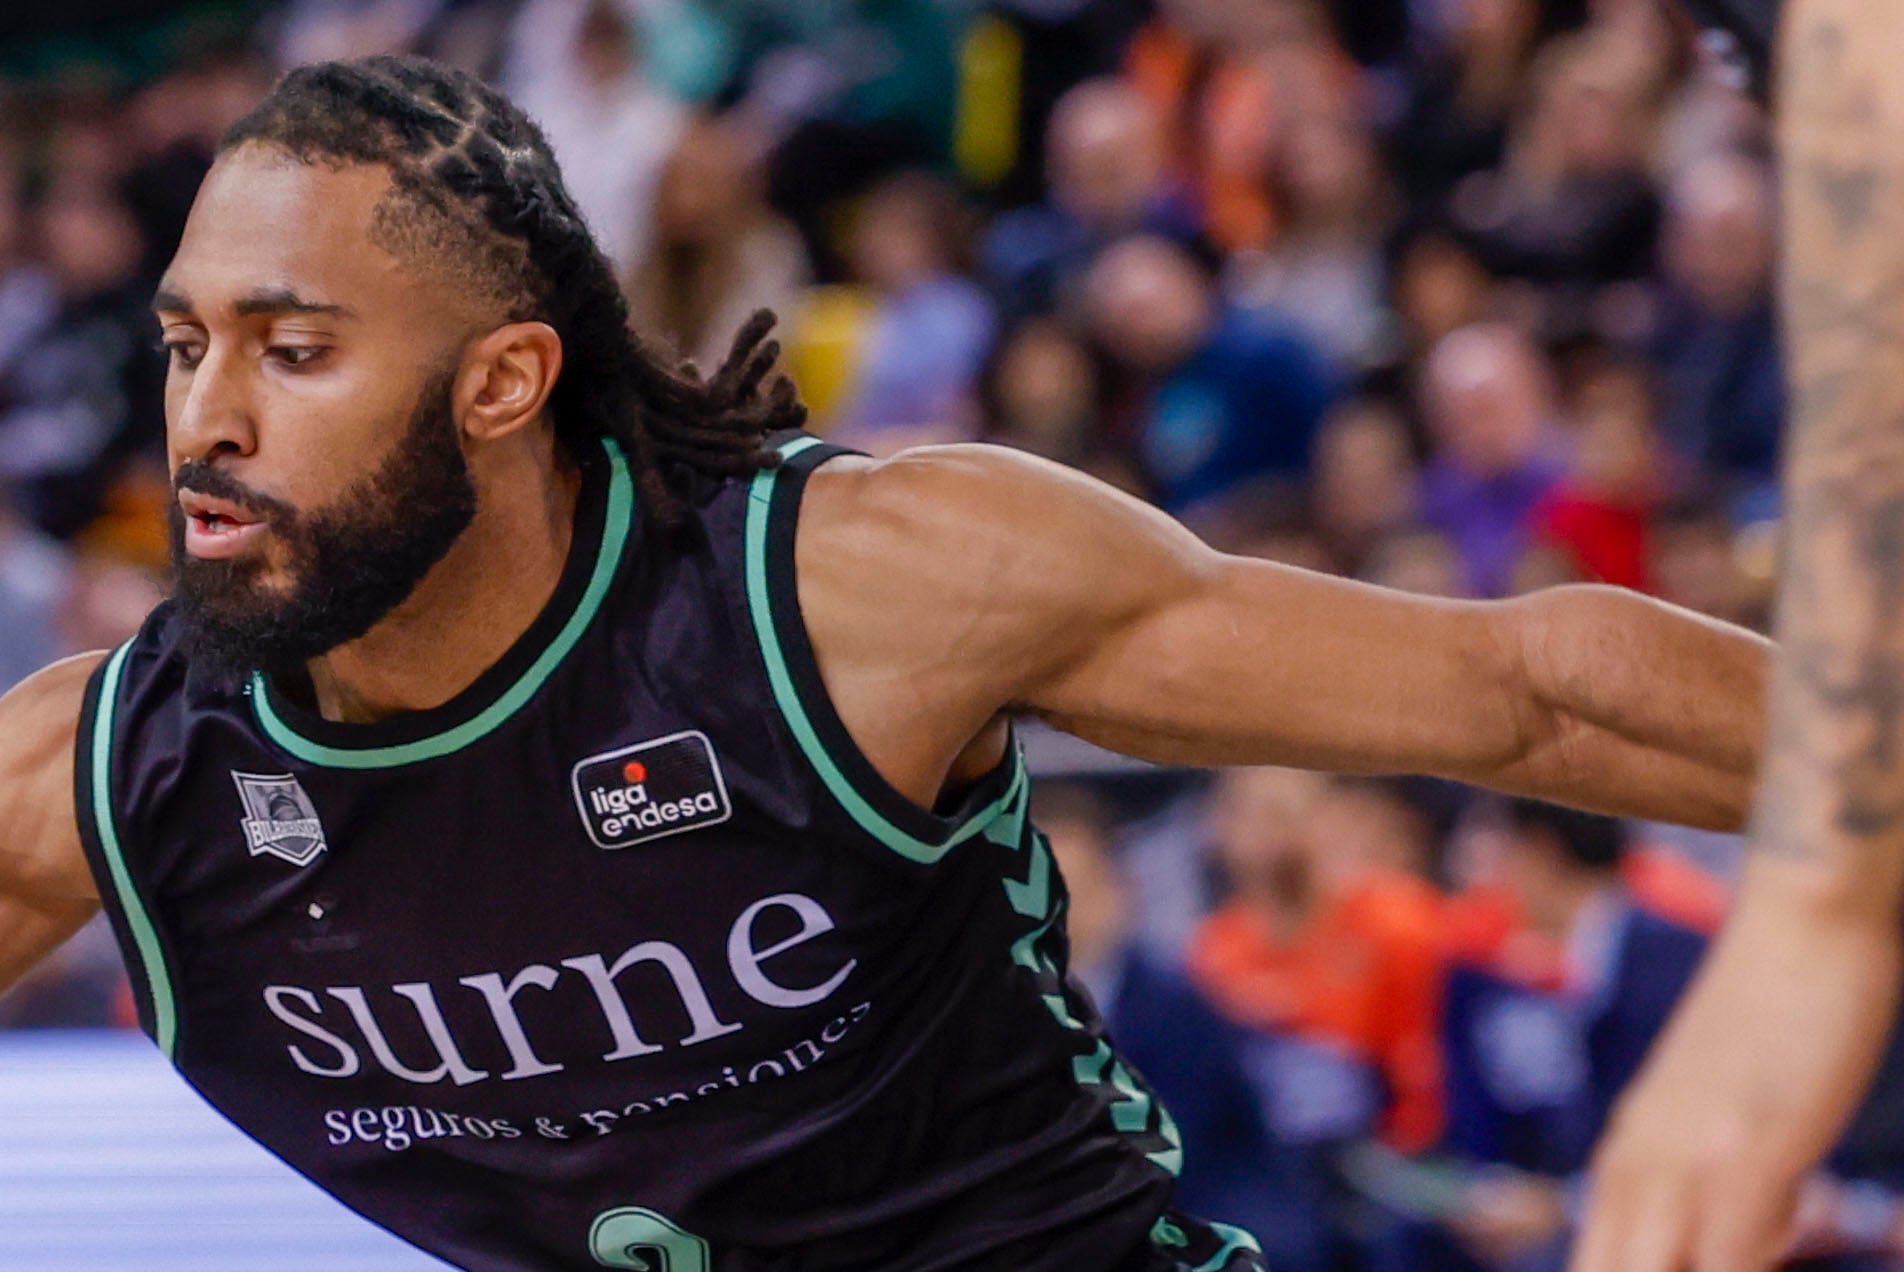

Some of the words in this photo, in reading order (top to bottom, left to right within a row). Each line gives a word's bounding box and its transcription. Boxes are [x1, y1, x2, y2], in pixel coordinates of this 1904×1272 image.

[589, 783, 648, 815] liga
[601, 790, 719, 838] endesa
[264, 891, 859, 1087] surne
[323, 1104, 523, 1152] seguros
